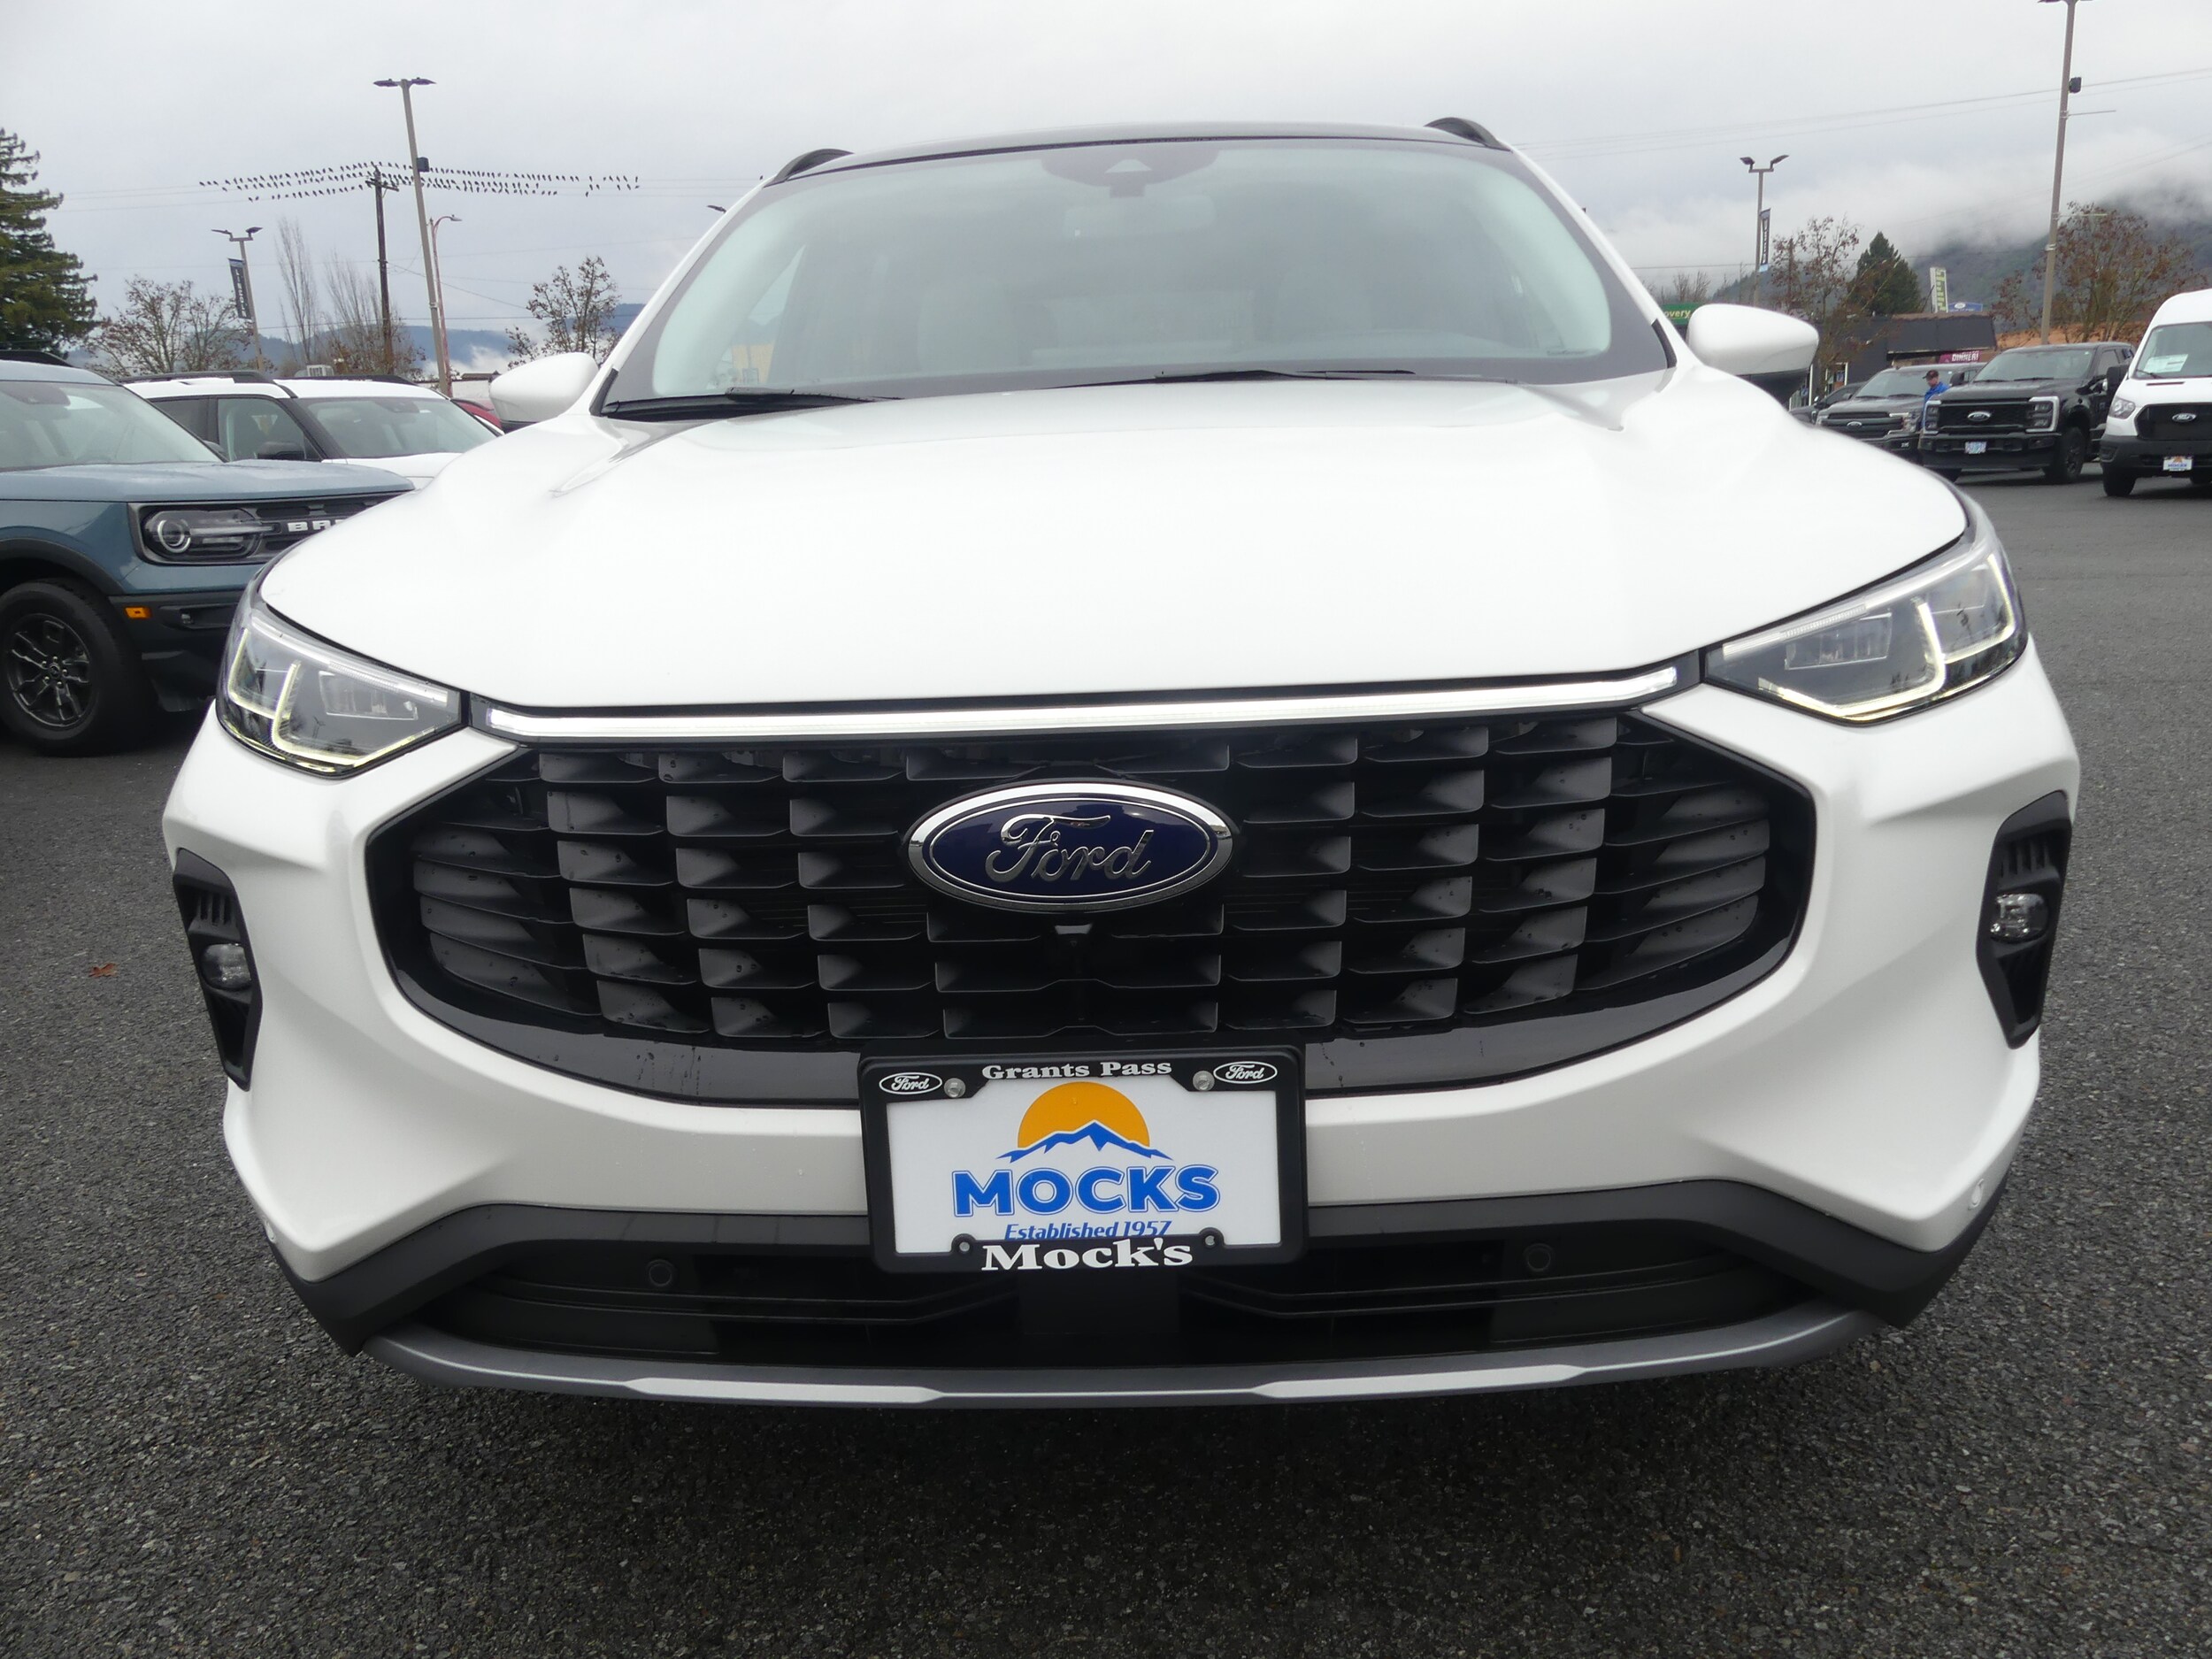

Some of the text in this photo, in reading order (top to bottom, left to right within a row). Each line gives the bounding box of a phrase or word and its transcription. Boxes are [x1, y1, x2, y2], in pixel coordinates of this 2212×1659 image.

[985, 814, 1154, 881] Ford
[982, 1062, 1172, 1079] Grants Pass
[1225, 1064, 1264, 1079] Ford
[891, 1075, 929, 1090] Ford
[951, 1164, 1220, 1217] MOCKS
[1004, 1220, 1172, 1240] Established 1957
[981, 1238, 1193, 1271] Mock's
